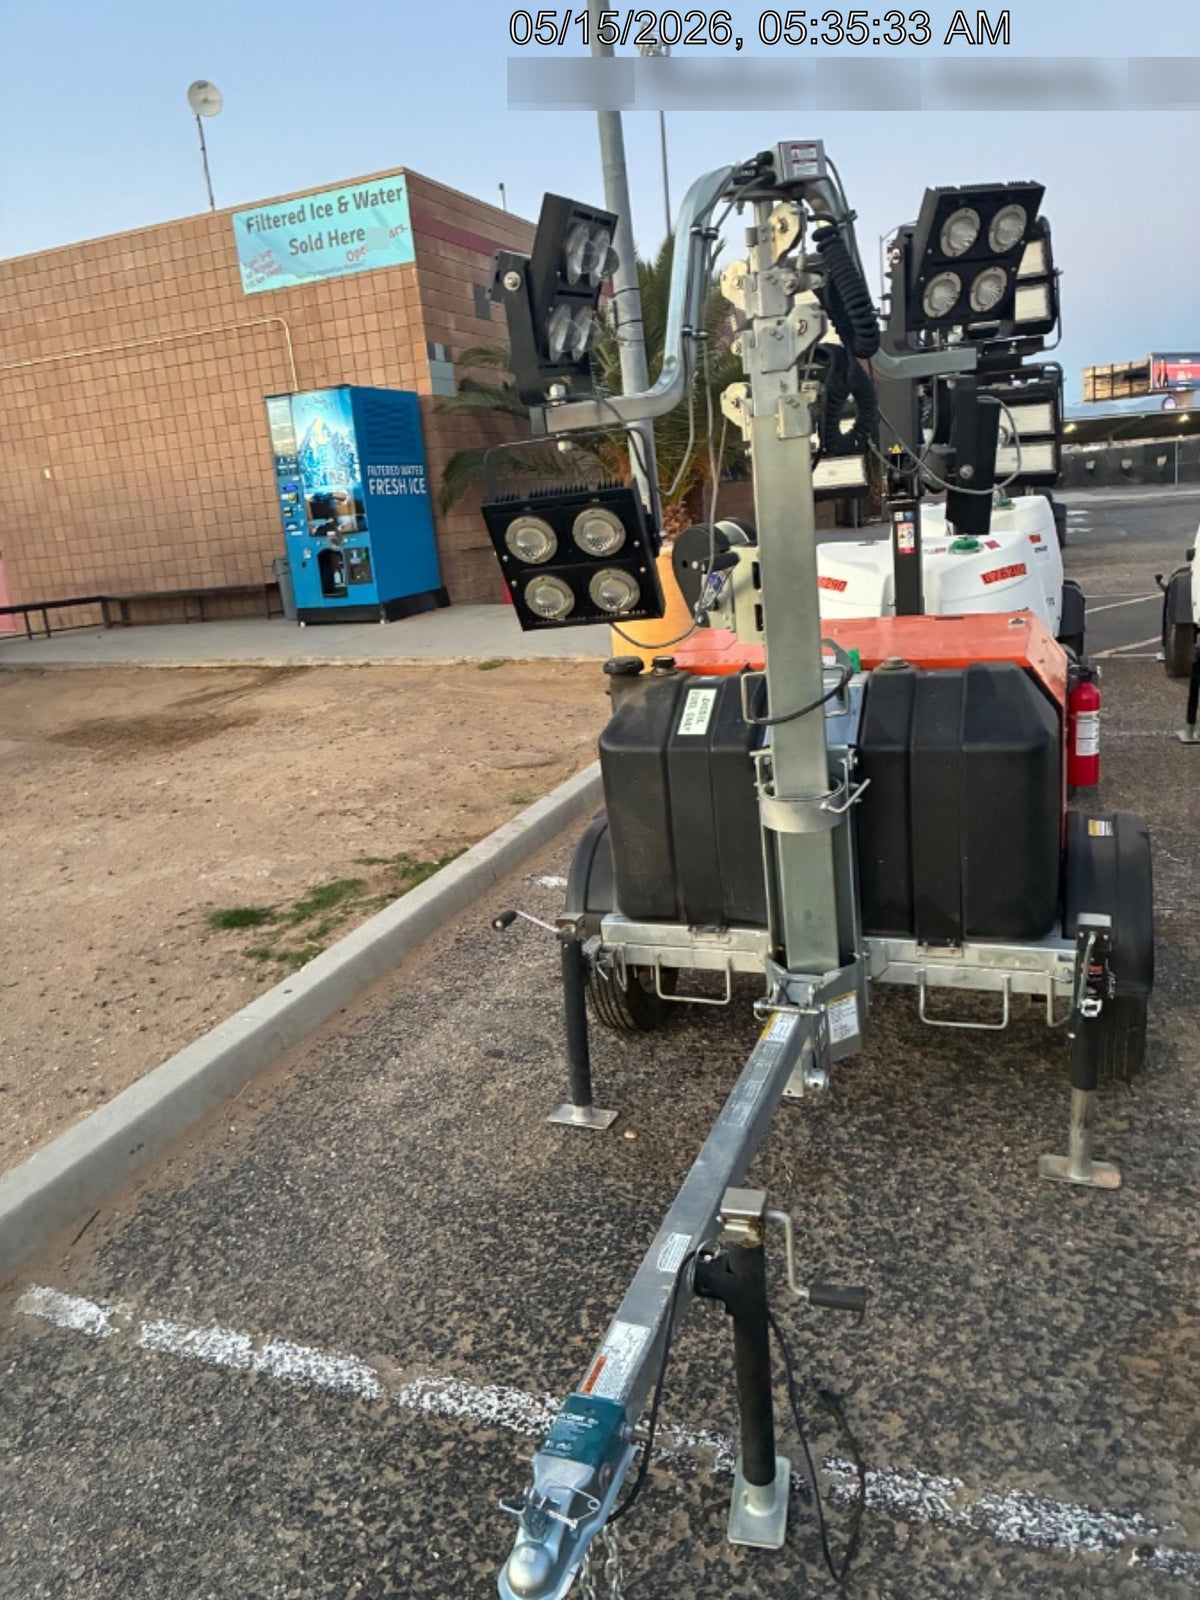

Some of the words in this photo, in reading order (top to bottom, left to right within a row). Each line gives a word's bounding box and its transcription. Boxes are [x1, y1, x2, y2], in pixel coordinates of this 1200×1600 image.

[246, 204, 306, 234] Filtered
[310, 203, 333, 220] Ice
[338, 195, 349, 214] &
[352, 187, 403, 210] Water
[289, 234, 324, 256] Sold
[328, 228, 365, 248] Here
[346, 245, 370, 262] Ope
[367, 465, 400, 476] FILTERED
[401, 465, 424, 475] WATER
[369, 478, 407, 495] FRESH
[409, 477, 427, 494] ICE
